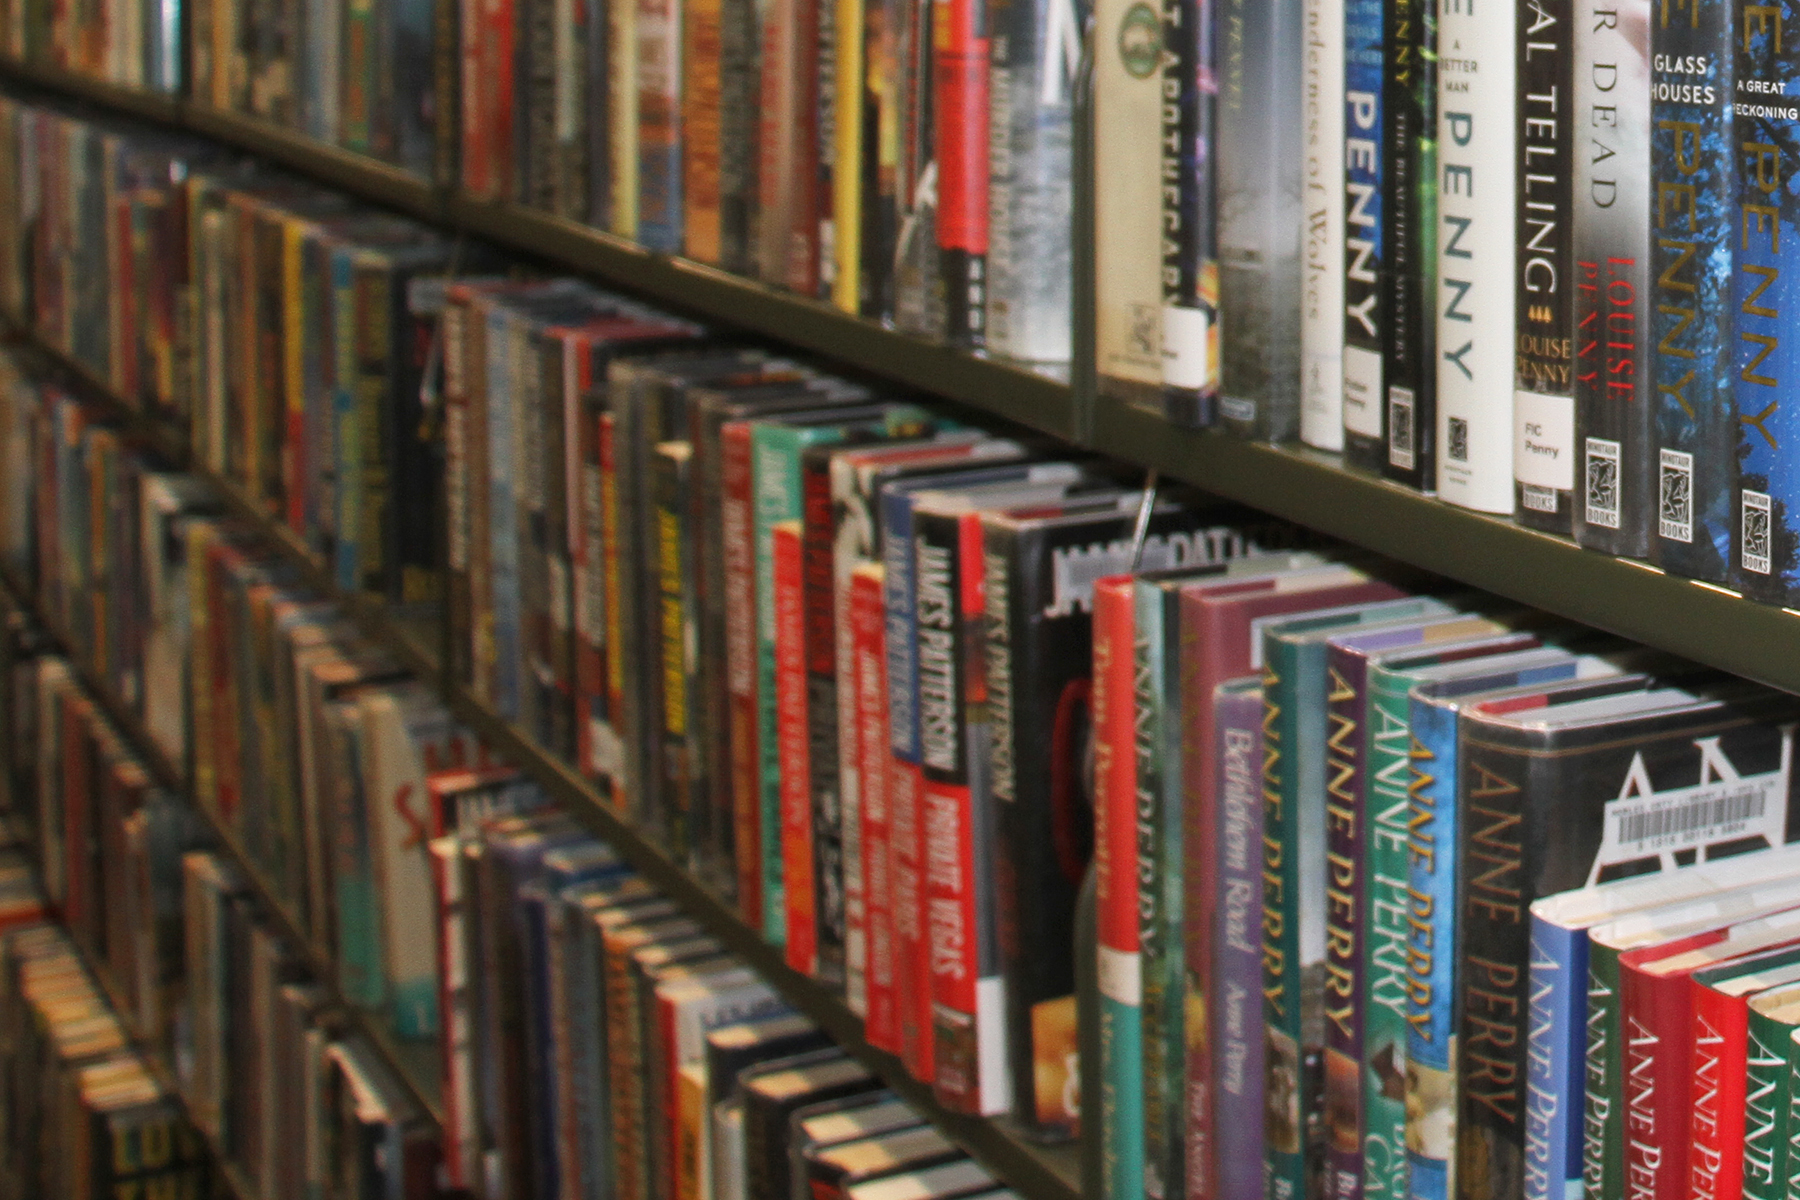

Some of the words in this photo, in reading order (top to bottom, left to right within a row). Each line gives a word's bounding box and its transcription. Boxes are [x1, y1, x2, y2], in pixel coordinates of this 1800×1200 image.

[1653, 54, 1708, 76] GLASS
[1746, 80, 1787, 96] GREAT
[1307, 155, 1330, 187] of
[1523, 85, 1558, 295] TELLING
[1591, 62, 1618, 211] DEAD
[1306, 207, 1329, 321] Wolves
[1346, 90, 1378, 338] PENNY
[1443, 110, 1475, 381] PENNY
[1523, 439, 1560, 460] Penny
[915, 537, 953, 638] JAMES
[985, 552, 1009, 641] JAMES
[919, 629, 958, 771] PATTERSON
[987, 644, 1016, 803] PATTERSON
[1260, 665, 1284, 830] ANNE
[1326, 668, 1358, 840] ANNE
[924, 794, 964, 891] PRIVATE
[1222, 726, 1255, 870] Bethlehem
[1406, 734, 1436, 875] ANNE
[1469, 761, 1523, 928] ANNE
[929, 896, 965, 979] VEGAS
[1225, 877, 1255, 955] Road
[1260, 844, 1285, 1032] PERRY
[1325, 855, 1357, 1043] PERRY
[1405, 893, 1433, 1045] PERRY
[1223, 978, 1246, 1031] Anne
[1463, 954, 1519, 1124] PERRY
[1527, 945, 1561, 1080] ANNE
[1584, 973, 1613, 1089] ANNE
[1626, 1016, 1660, 1136] ANNE
[1692, 1015, 1725, 1135] ANNE
